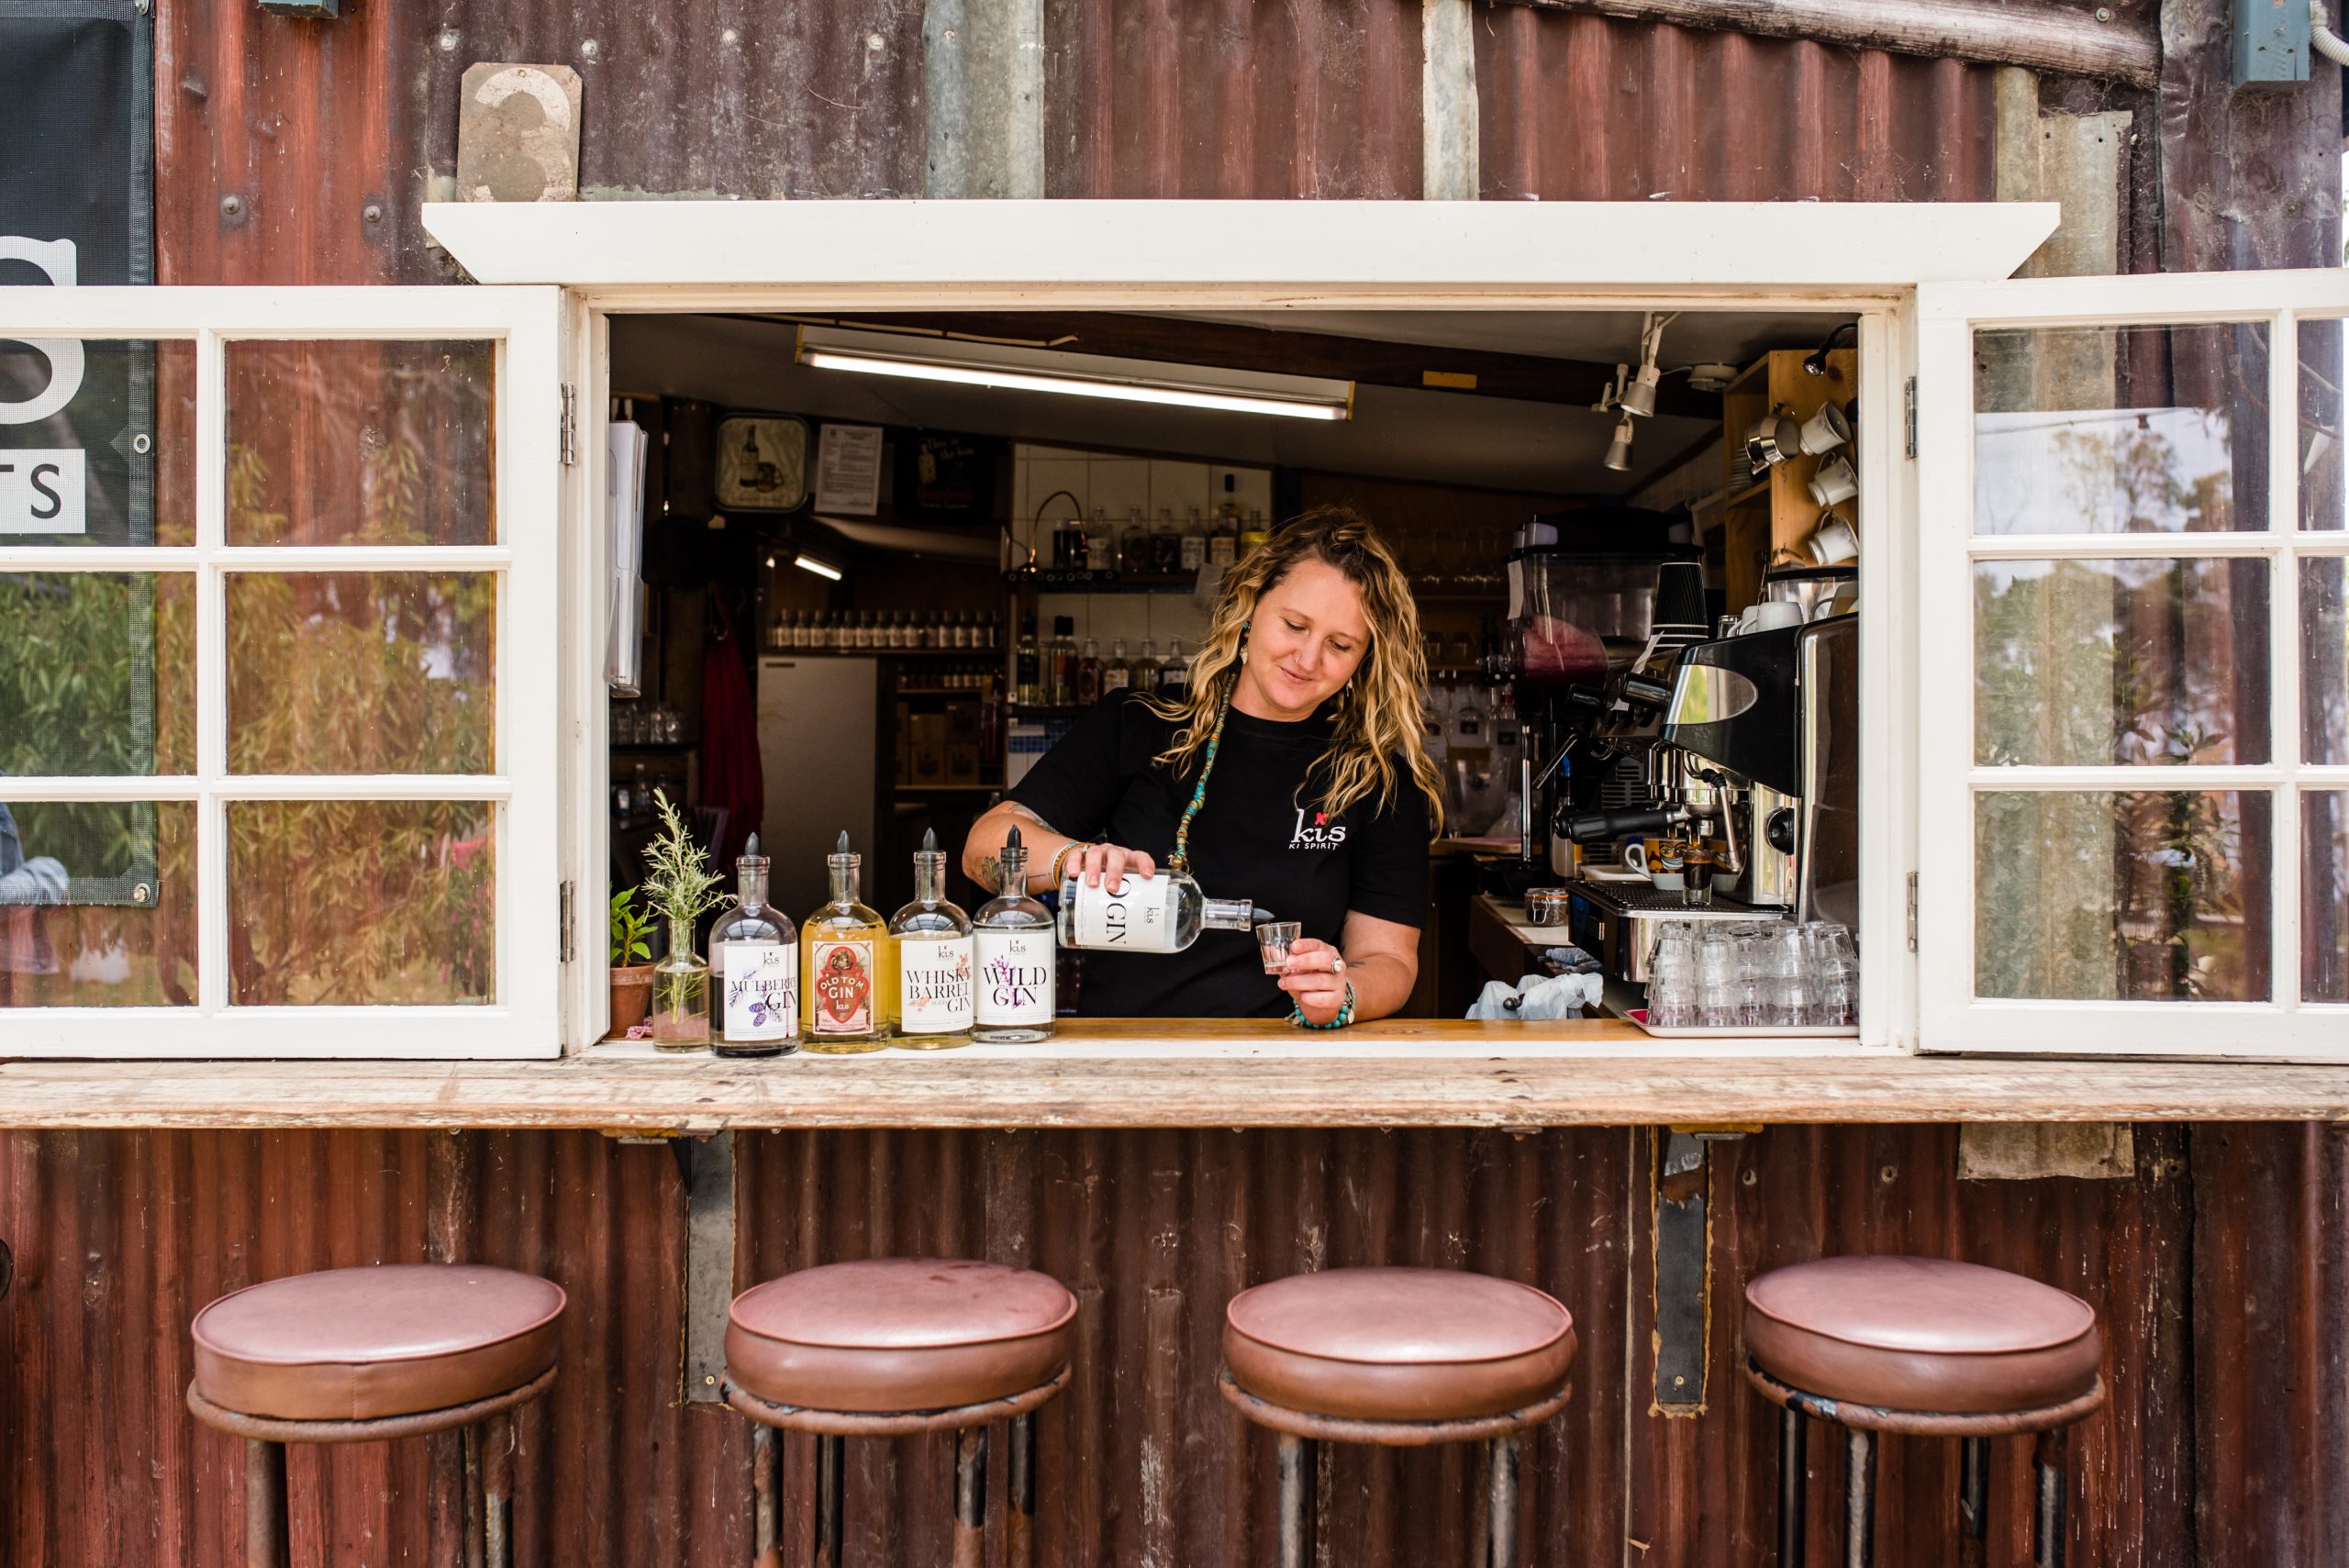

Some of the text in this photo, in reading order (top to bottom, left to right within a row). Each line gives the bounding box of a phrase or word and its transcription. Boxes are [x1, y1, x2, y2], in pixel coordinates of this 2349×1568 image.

[1290, 808, 1346, 843] kis
[1304, 842, 1339, 851] SPIRIT
[1106, 903, 1127, 944] GIN
[938, 945, 954, 959] kis
[1009, 940, 1027, 953] kis
[763, 951, 780, 965] kis
[730, 976, 796, 992] MULBERRY
[819, 976, 864, 990] OLD TOM
[906, 968, 971, 984] WHISKY
[984, 966, 1048, 986] WILD
[828, 986, 854, 999] GIN
[909, 982, 972, 999] BARREL
[993, 986, 1038, 1006] GIN
[765, 990, 796, 1011] GIN
[947, 996, 972, 1013] GIN
